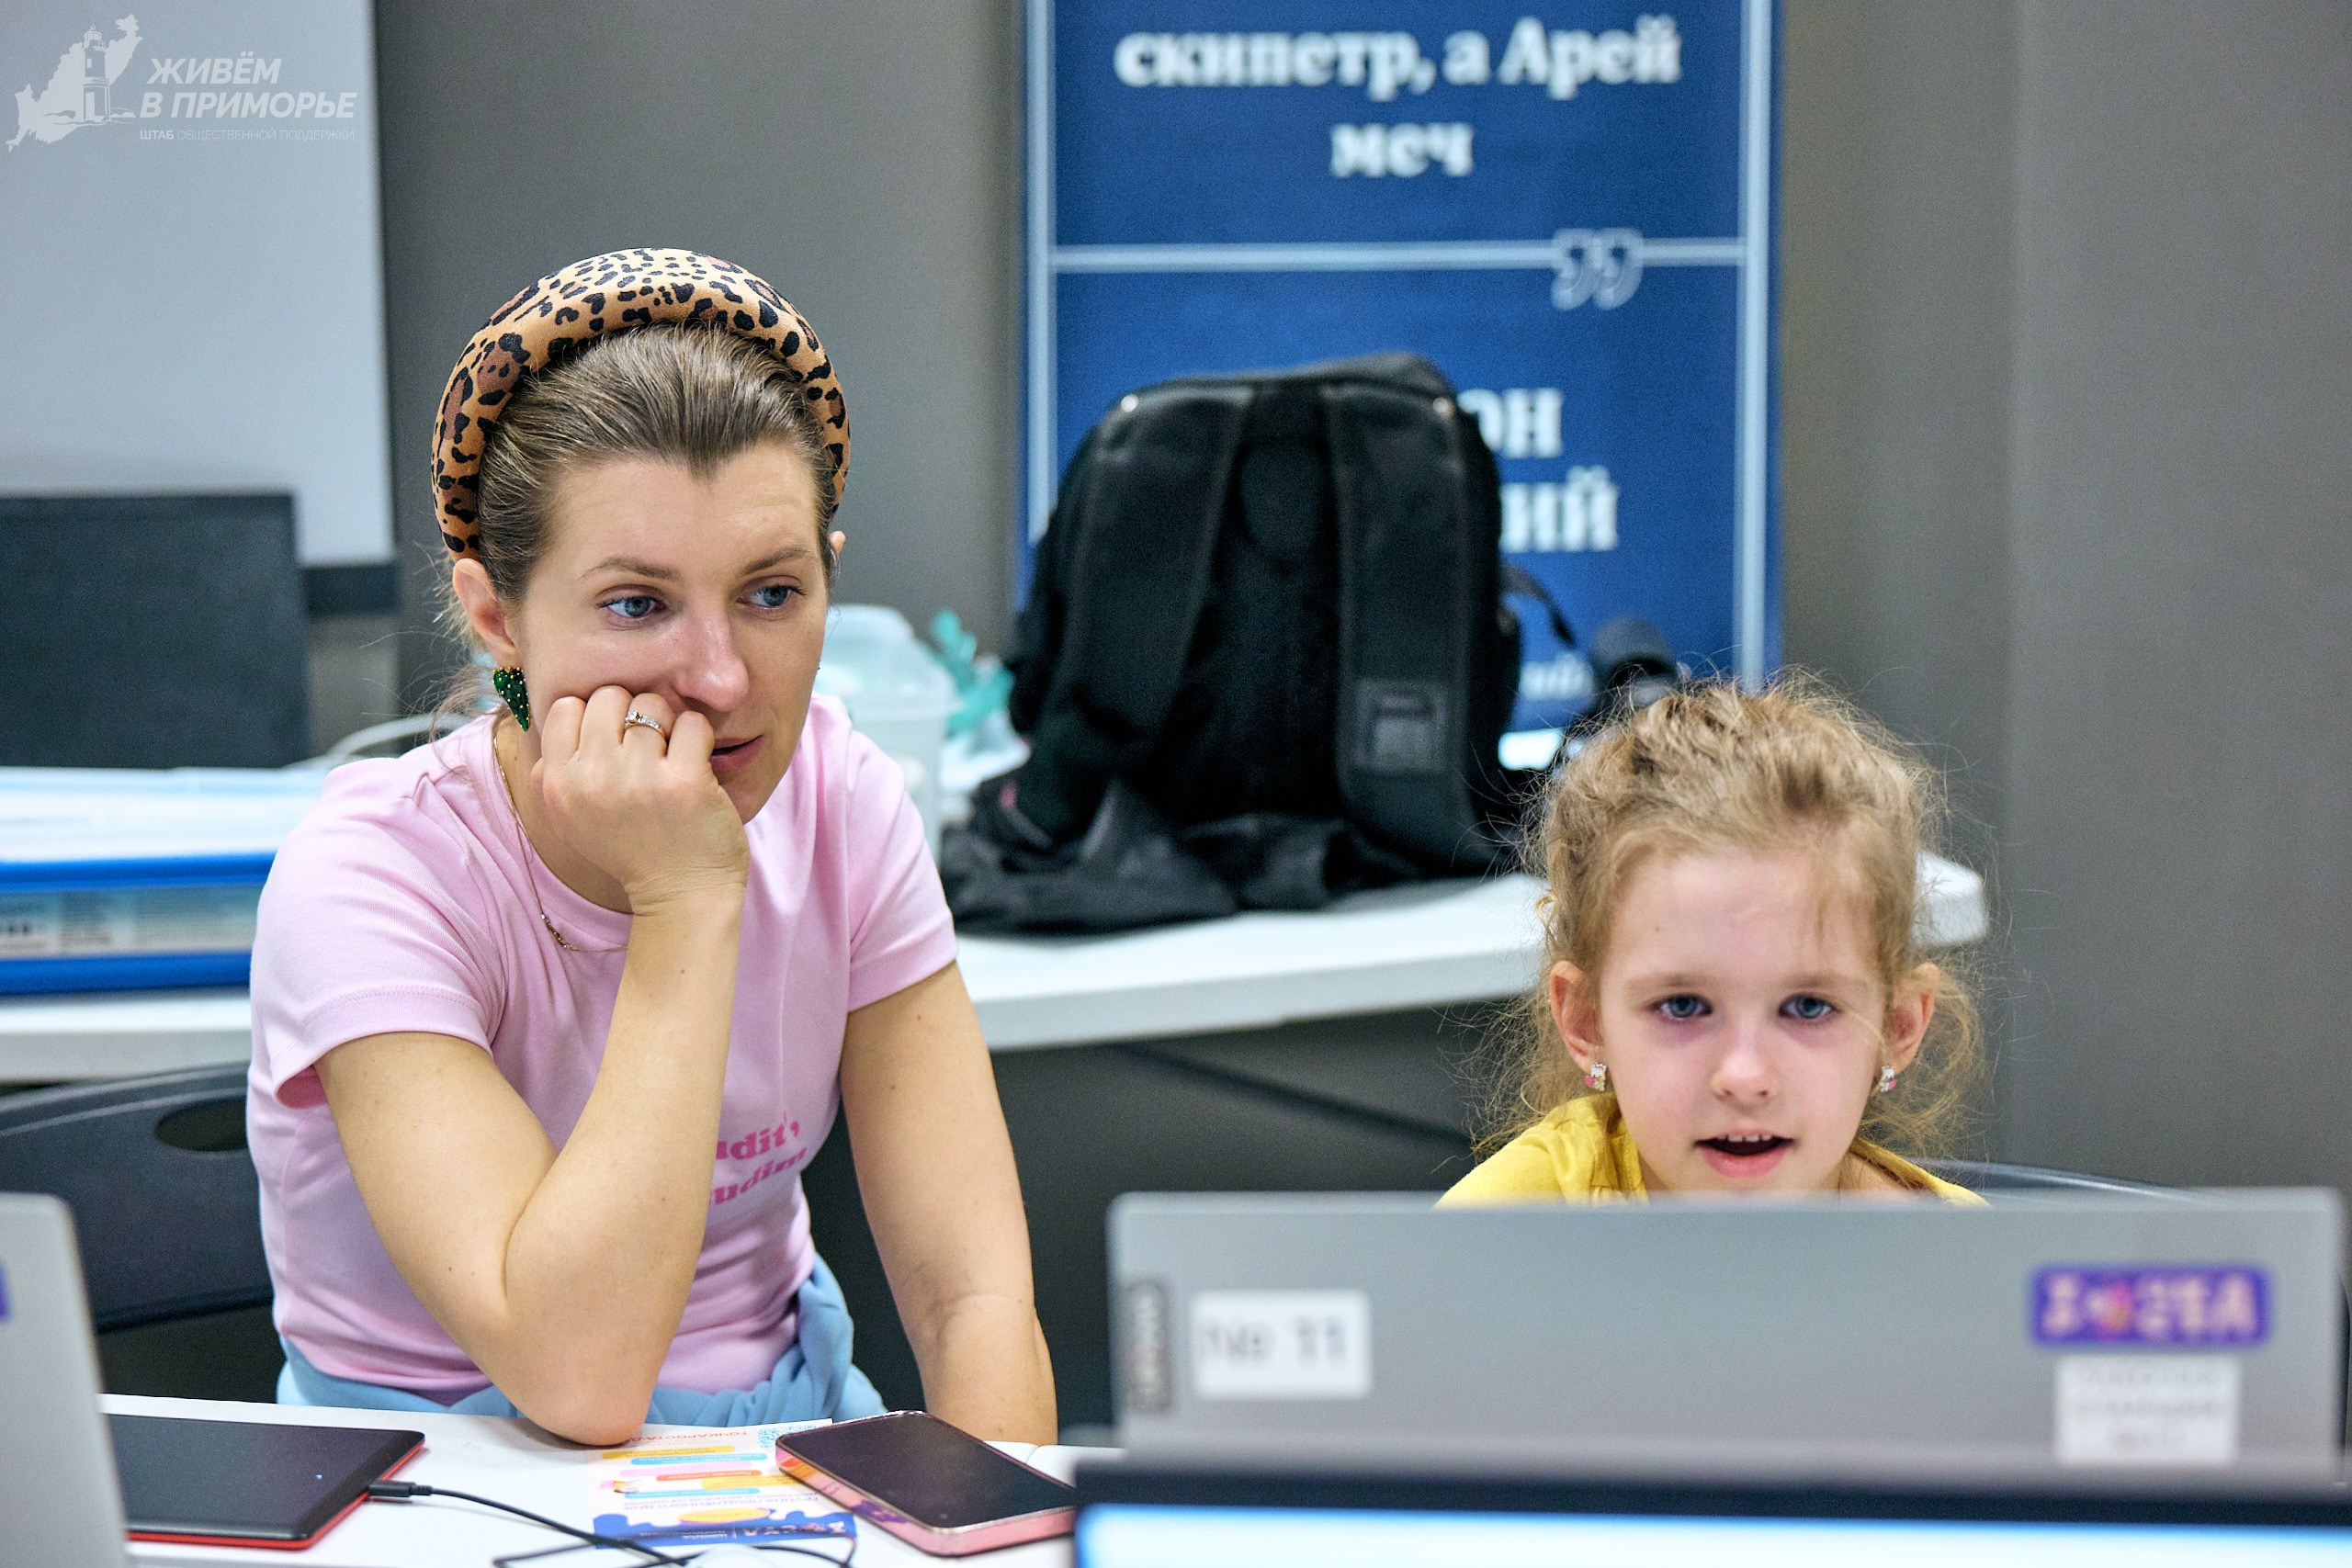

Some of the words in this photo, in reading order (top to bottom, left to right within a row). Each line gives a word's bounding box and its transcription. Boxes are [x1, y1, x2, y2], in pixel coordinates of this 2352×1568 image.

[1114, 32, 1435, 101] скипетр,
[1442, 31, 1489, 85] а
[1498, 16, 1681, 100] Арей
[1330, 122, 1473, 178] меч
[1456, 388, 1563, 457] он
[1501, 465, 1618, 551] ий
